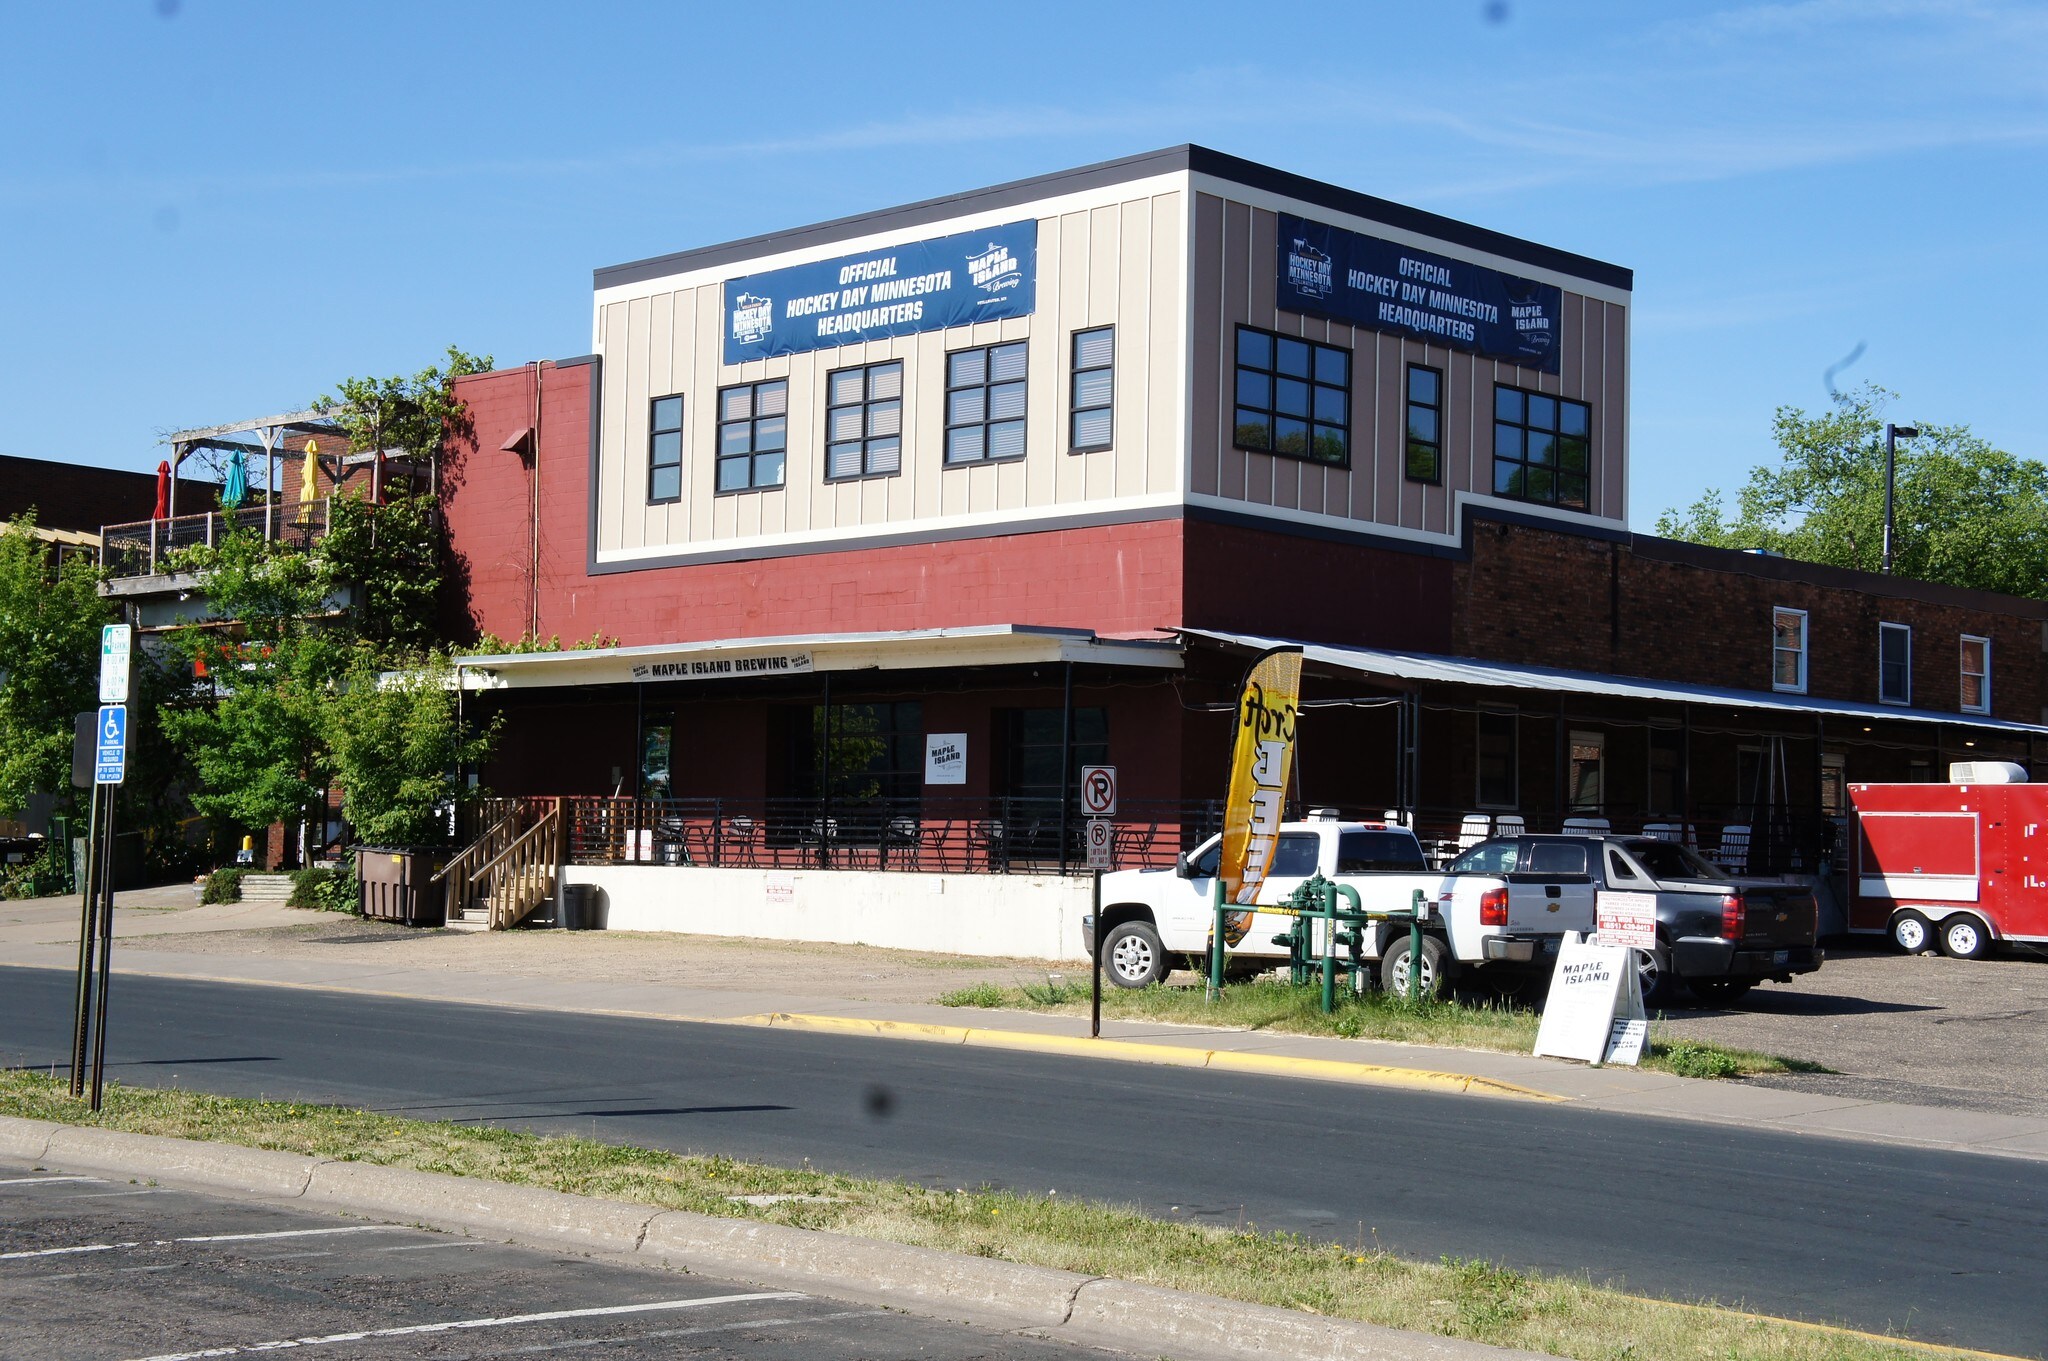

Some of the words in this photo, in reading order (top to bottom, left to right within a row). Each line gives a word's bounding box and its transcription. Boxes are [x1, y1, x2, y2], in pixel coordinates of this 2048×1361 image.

[968, 247, 1008, 274] MAPLE
[1290, 254, 1317, 271] HOCKEY
[1318, 262, 1330, 275] DAY
[839, 257, 897, 286] OFFICIAL
[973, 258, 1017, 286] ISLAND
[1290, 266, 1331, 286] MINNESOTA
[1399, 257, 1452, 288] OFFICIAL
[992, 278, 1020, 292] Brewing
[786, 292, 838, 318] HOCKEY
[841, 286, 869, 310] DAY
[872, 270, 951, 304] MINNESOTA
[1348, 268, 1398, 298] HOCKEY
[1402, 282, 1426, 304] DAY
[1428, 290, 1498, 324] MINNESOTA
[734, 307, 758, 320] HOCKEY
[758, 304, 771, 318] DAY
[818, 301, 923, 336] HEADQUARTERS
[1512, 306, 1542, 317] MAPLE
[734, 318, 771, 332] MINNESOTA
[1378, 301, 1475, 342] HEADQUARTERS
[1516, 318, 1549, 330] ISLAND
[105, 632, 112, 650] 4
[652, 662, 688, 676] MAPLE
[691, 660, 731, 674] ISLAND
[735, 656, 789, 672] BREWING
[791, 654, 805, 663] MAPLE
[794, 659, 809, 668] ISLAND
[635, 669, 649, 677] ISLAND
[932, 745, 955, 757] MAPLE
[935, 752, 961, 765] ISLAND
[1563, 961, 1603, 974] MAPLE
[1566, 972, 1610, 985] ISLAND
